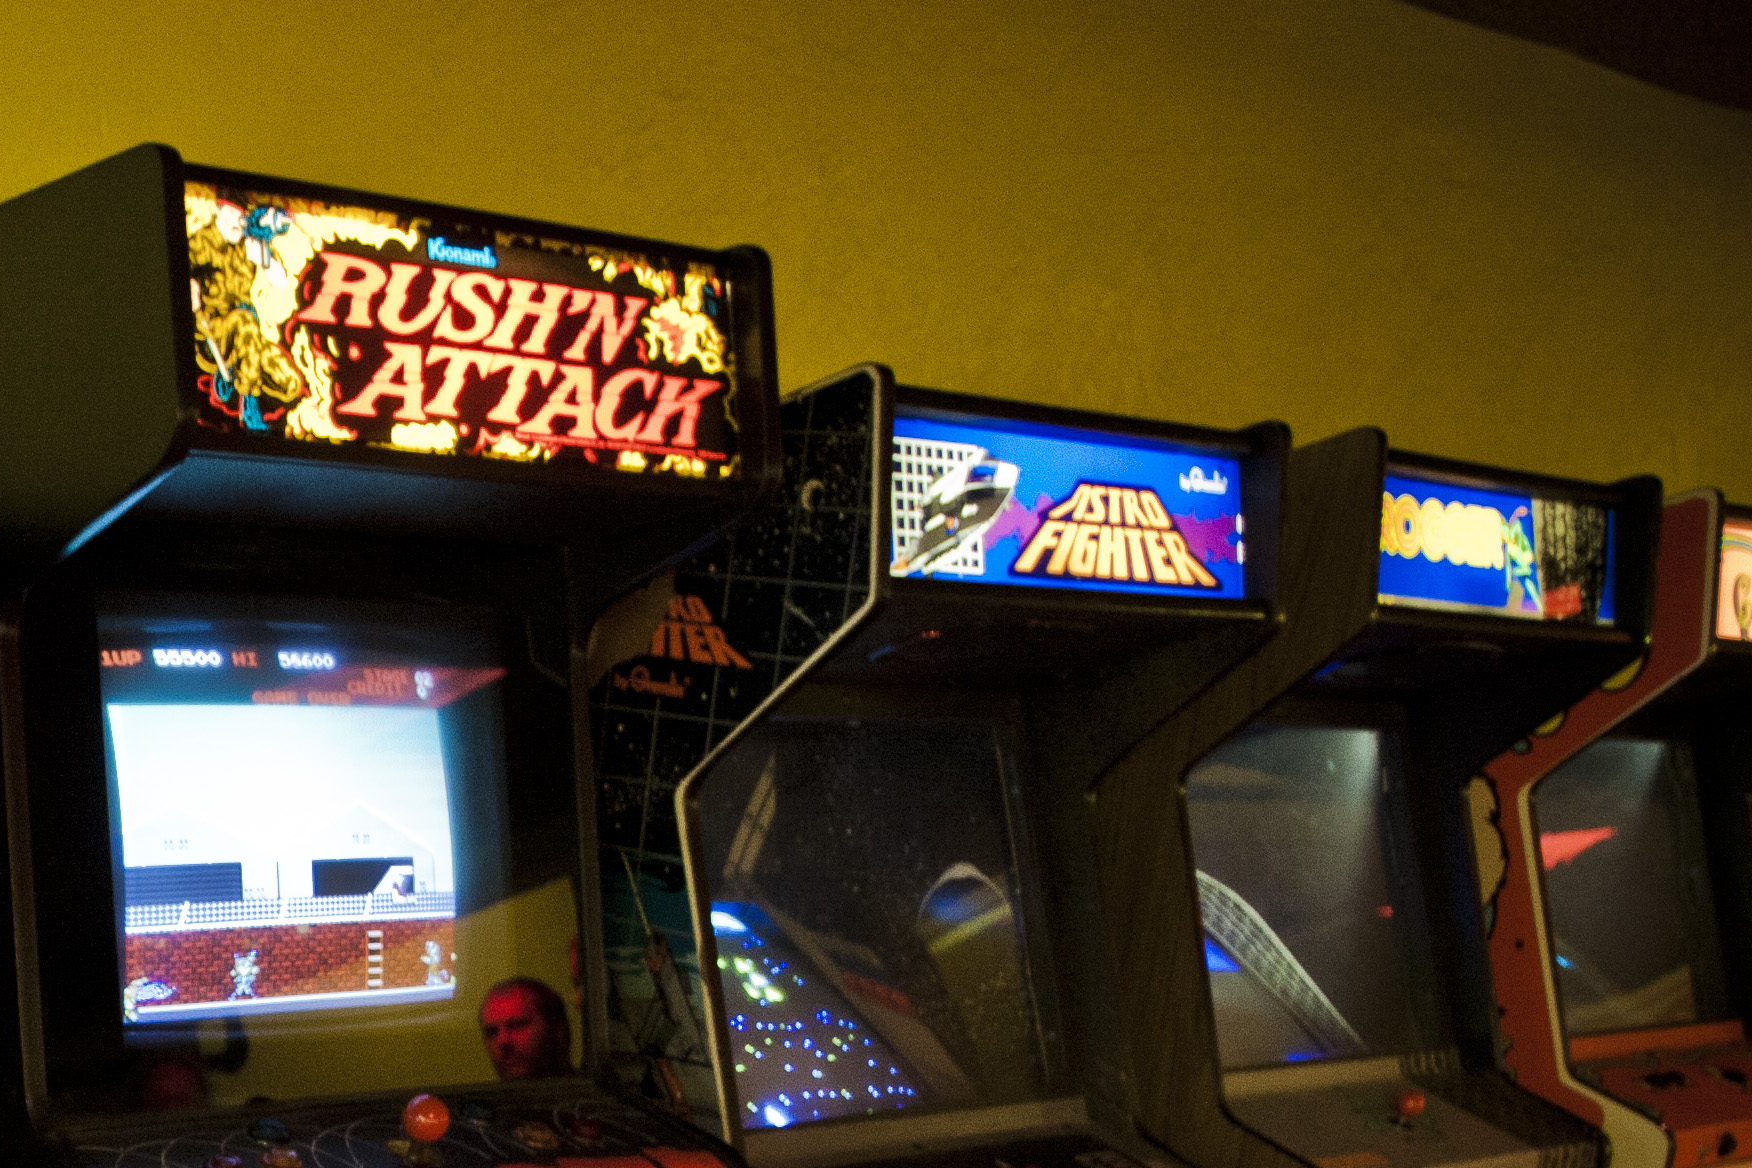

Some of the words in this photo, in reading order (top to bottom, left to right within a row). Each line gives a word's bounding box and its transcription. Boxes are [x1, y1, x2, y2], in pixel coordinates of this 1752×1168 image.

[295, 252, 648, 365] RUSH'N
[336, 339, 723, 447] ATTACK
[1047, 483, 1173, 530] ASTRO
[1013, 519, 1220, 588] FIGHTER
[100, 648, 144, 668] 1UP
[152, 647, 224, 669] 55500
[230, 650, 259, 669] HI
